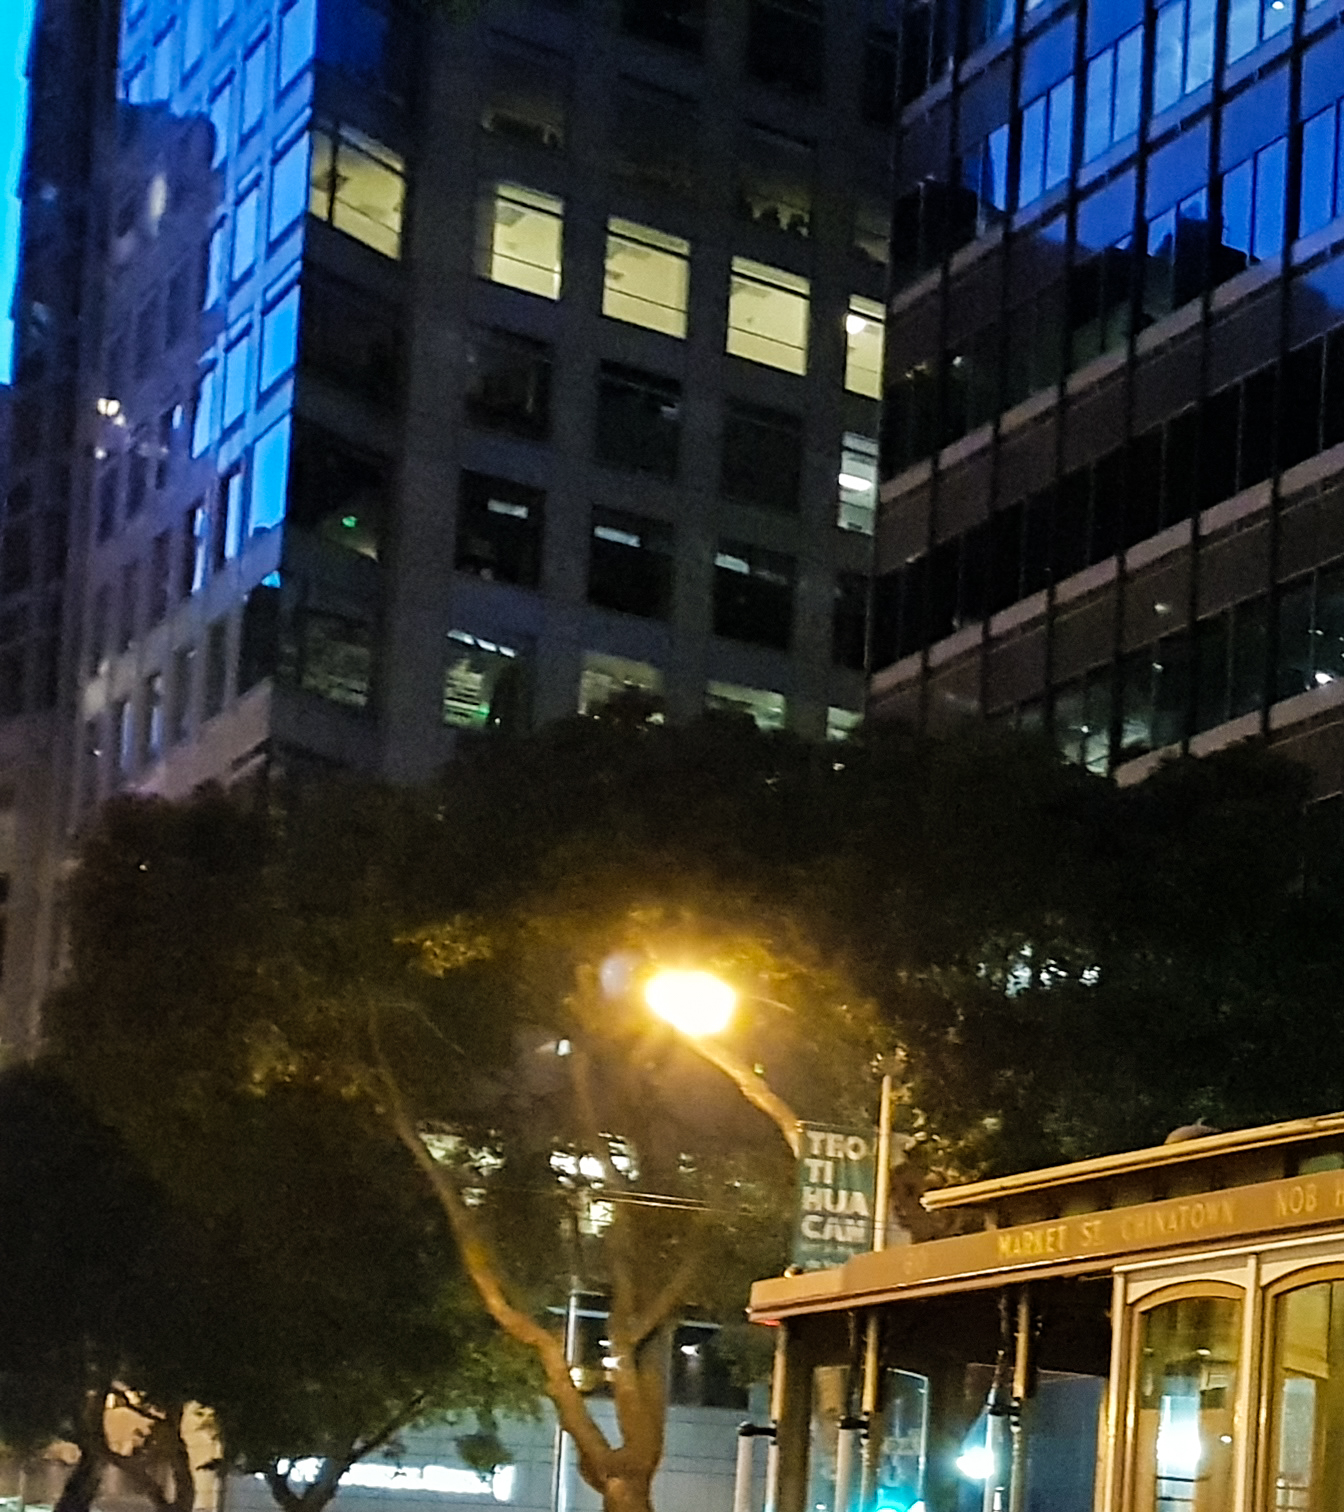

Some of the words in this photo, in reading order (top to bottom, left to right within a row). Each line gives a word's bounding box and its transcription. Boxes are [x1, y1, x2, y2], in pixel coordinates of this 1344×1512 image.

[806, 1131, 868, 1161] TEO
[803, 1158, 833, 1185] TI
[801, 1186, 870, 1216] HUA
[1276, 1184, 1317, 1217] NOB
[801, 1214, 868, 1243] CAN
[997, 1225, 1068, 1259] MARKET
[1121, 1198, 1236, 1241] CHINATOWN
